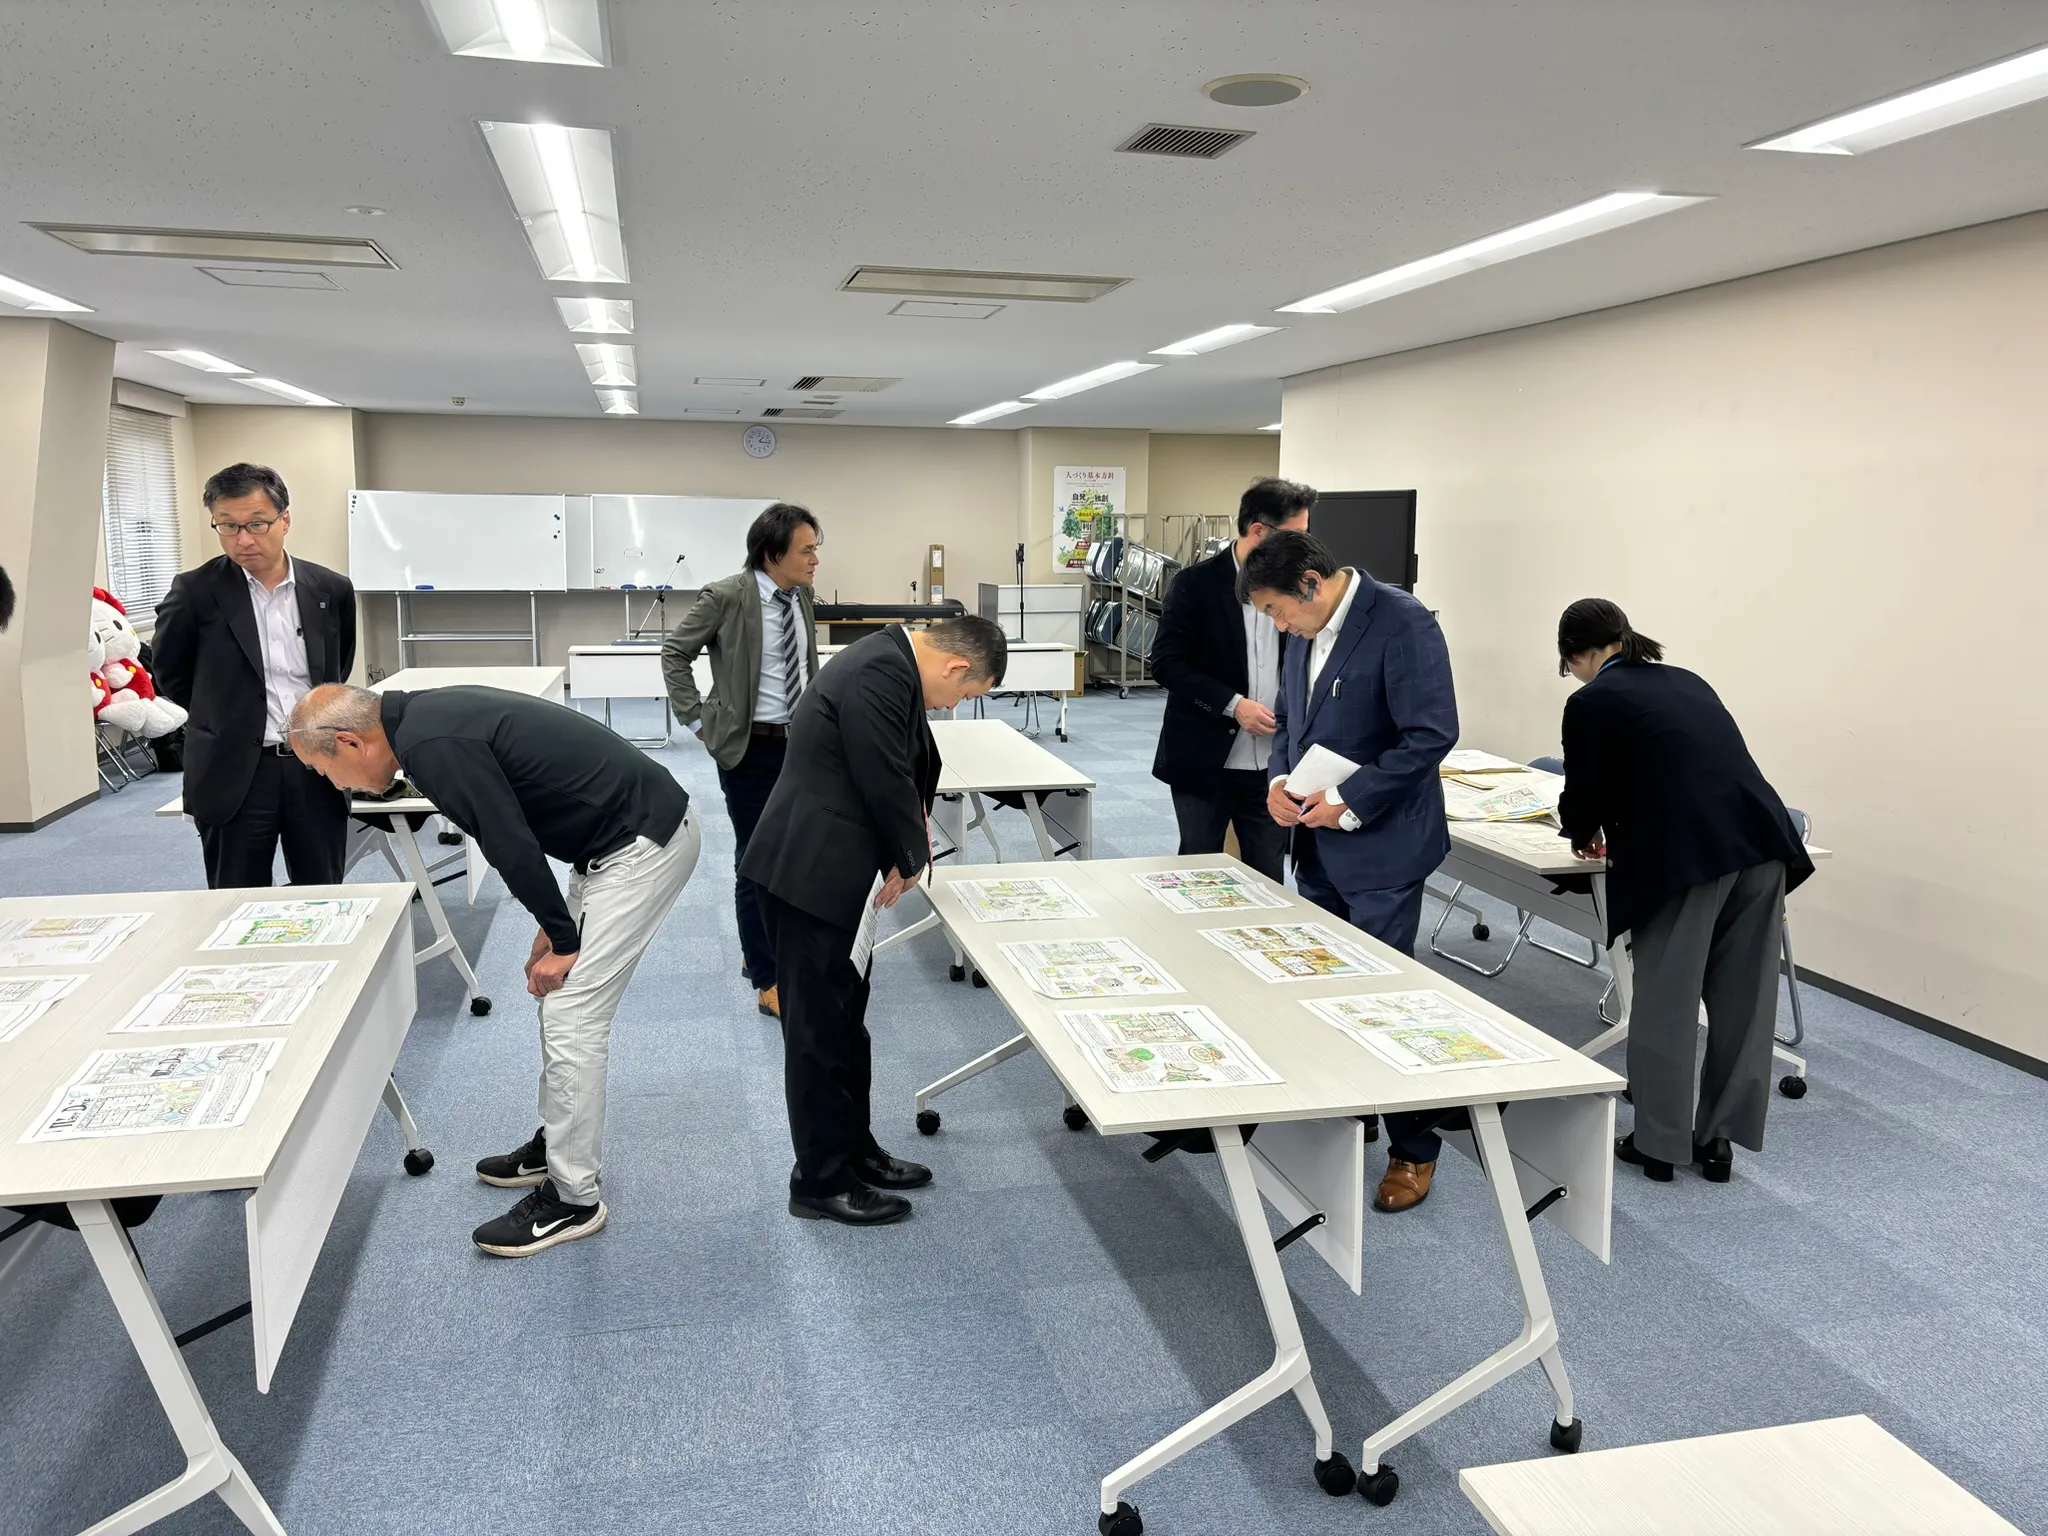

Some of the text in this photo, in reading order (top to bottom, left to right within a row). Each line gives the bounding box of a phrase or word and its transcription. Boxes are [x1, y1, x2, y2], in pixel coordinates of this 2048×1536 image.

[1066, 471, 1115, 480] 人づくり基本方針
[1072, 493, 1086, 501] 自発
[1094, 494, 1109, 502] 独創
